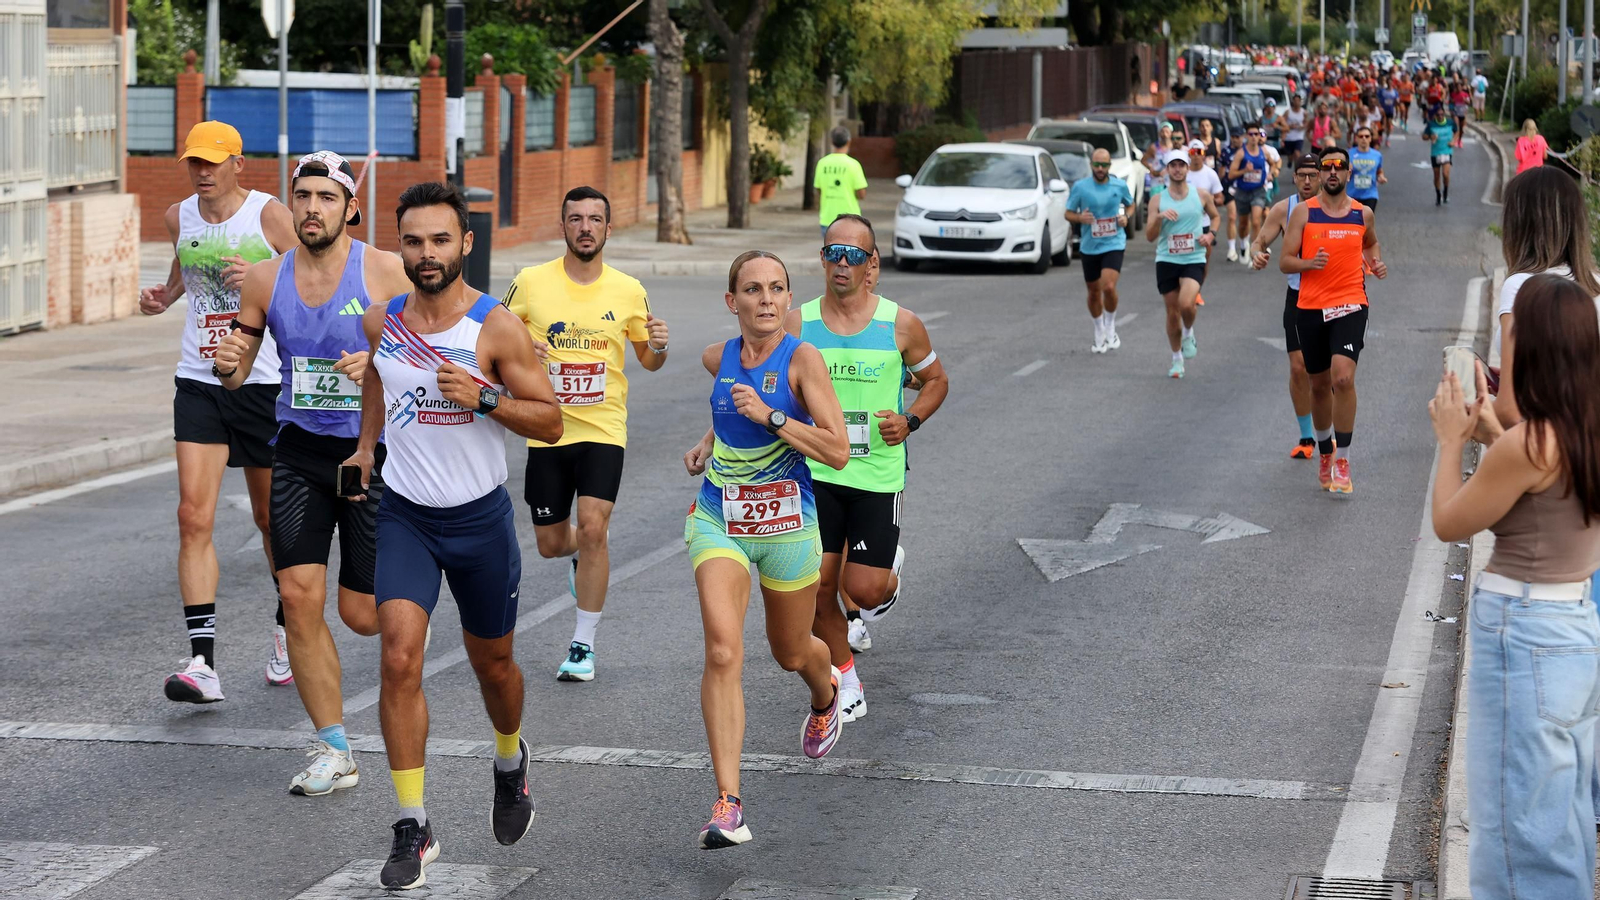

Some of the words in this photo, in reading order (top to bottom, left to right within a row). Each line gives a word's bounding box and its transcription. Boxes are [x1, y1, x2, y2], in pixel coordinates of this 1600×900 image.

[557, 338, 590, 350] WORLD
[591, 339, 609, 350] RUN
[315, 375, 340, 393] 42
[562, 377, 593, 391] 517
[742, 500, 781, 520] 299
